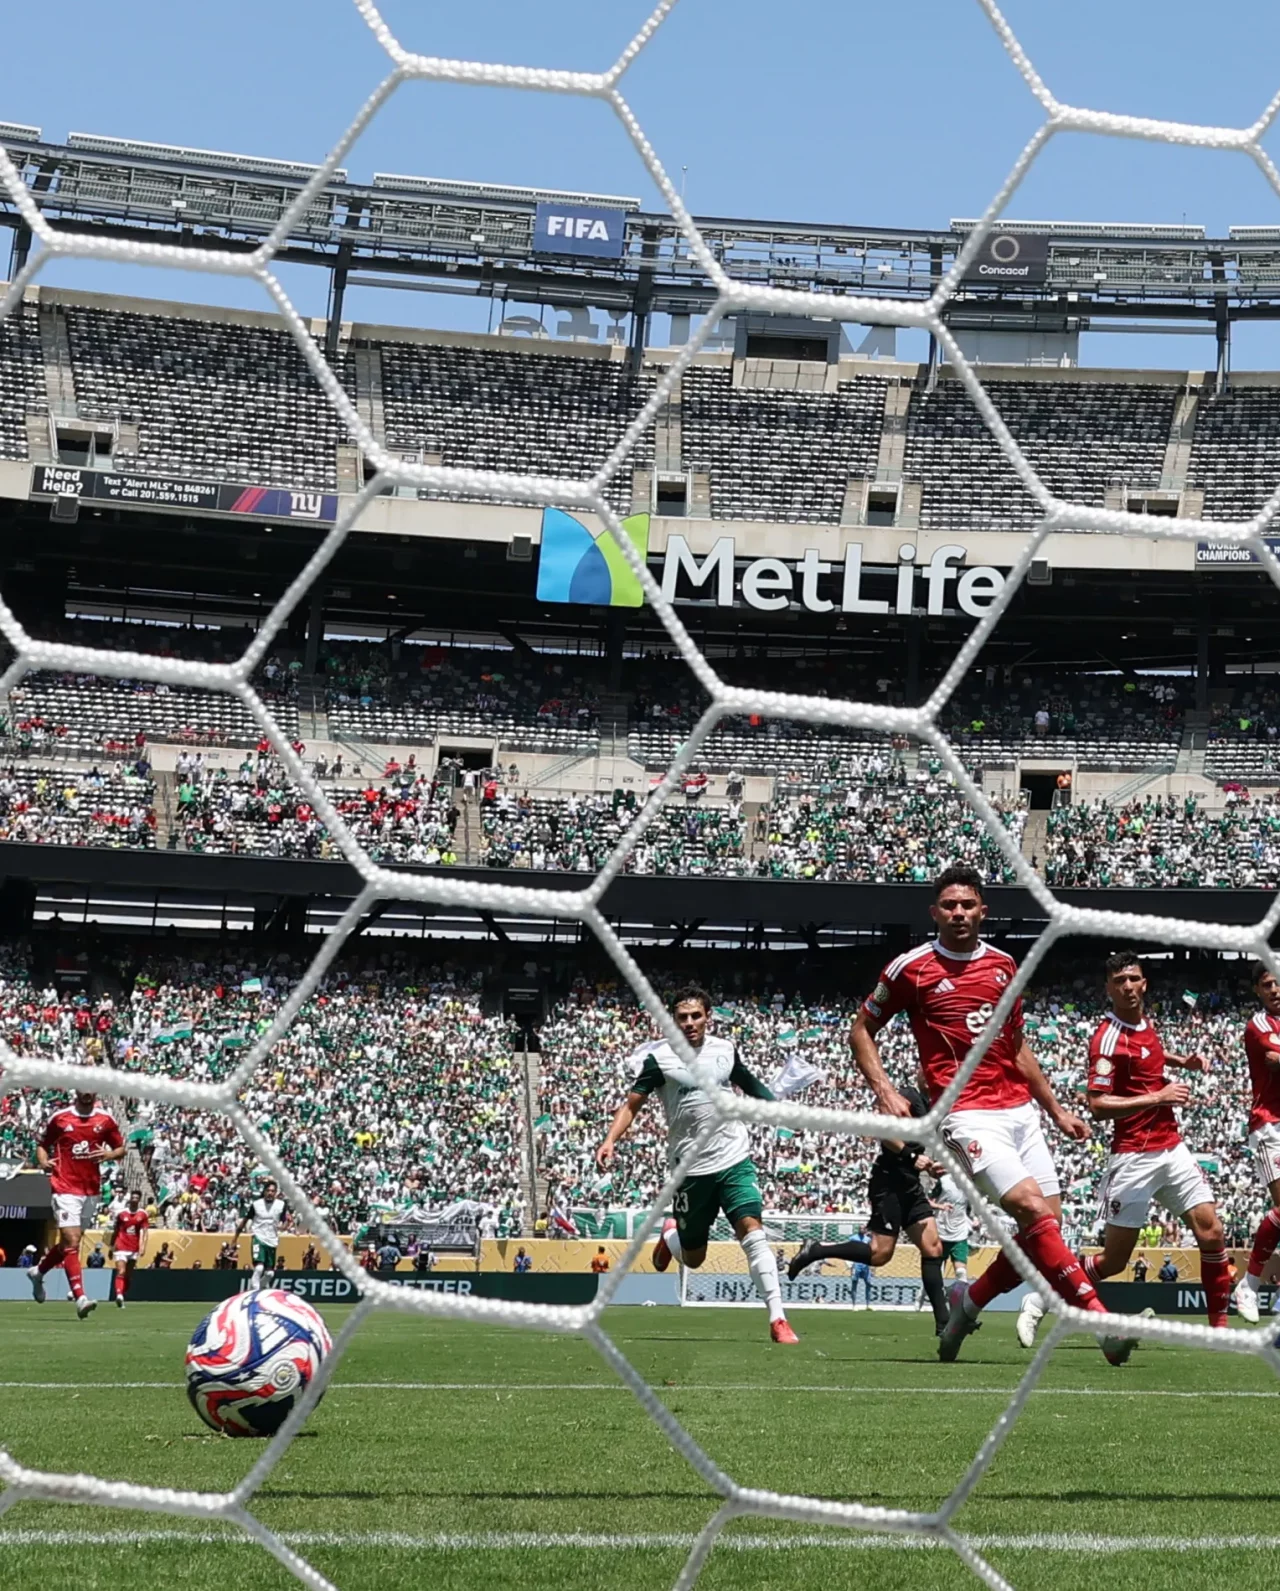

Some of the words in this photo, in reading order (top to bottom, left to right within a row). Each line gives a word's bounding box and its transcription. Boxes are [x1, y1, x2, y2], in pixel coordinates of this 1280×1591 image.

[547, 215, 609, 241] FIFA
[979, 264, 1029, 275] Concacaf
[44, 467, 80, 481] Need
[42, 479, 83, 494] Help?
[103, 476, 122, 486] Text
[123, 478, 148, 488] "Alert
[149, 481, 172, 491] MLS"
[174, 484, 182, 492] to
[184, 484, 215, 495] 848261
[110, 488, 119, 496] or
[121, 488, 138, 497] Call
[140, 490, 199, 503] 201.559.1515
[290, 492, 322, 518] ny
[1197, 550, 1250, 561] CHAMPIONS
[660, 534, 1007, 618] MetLife
[673, 1191, 690, 1212] 23
[1058, 1261, 1081, 1281] AHLY
